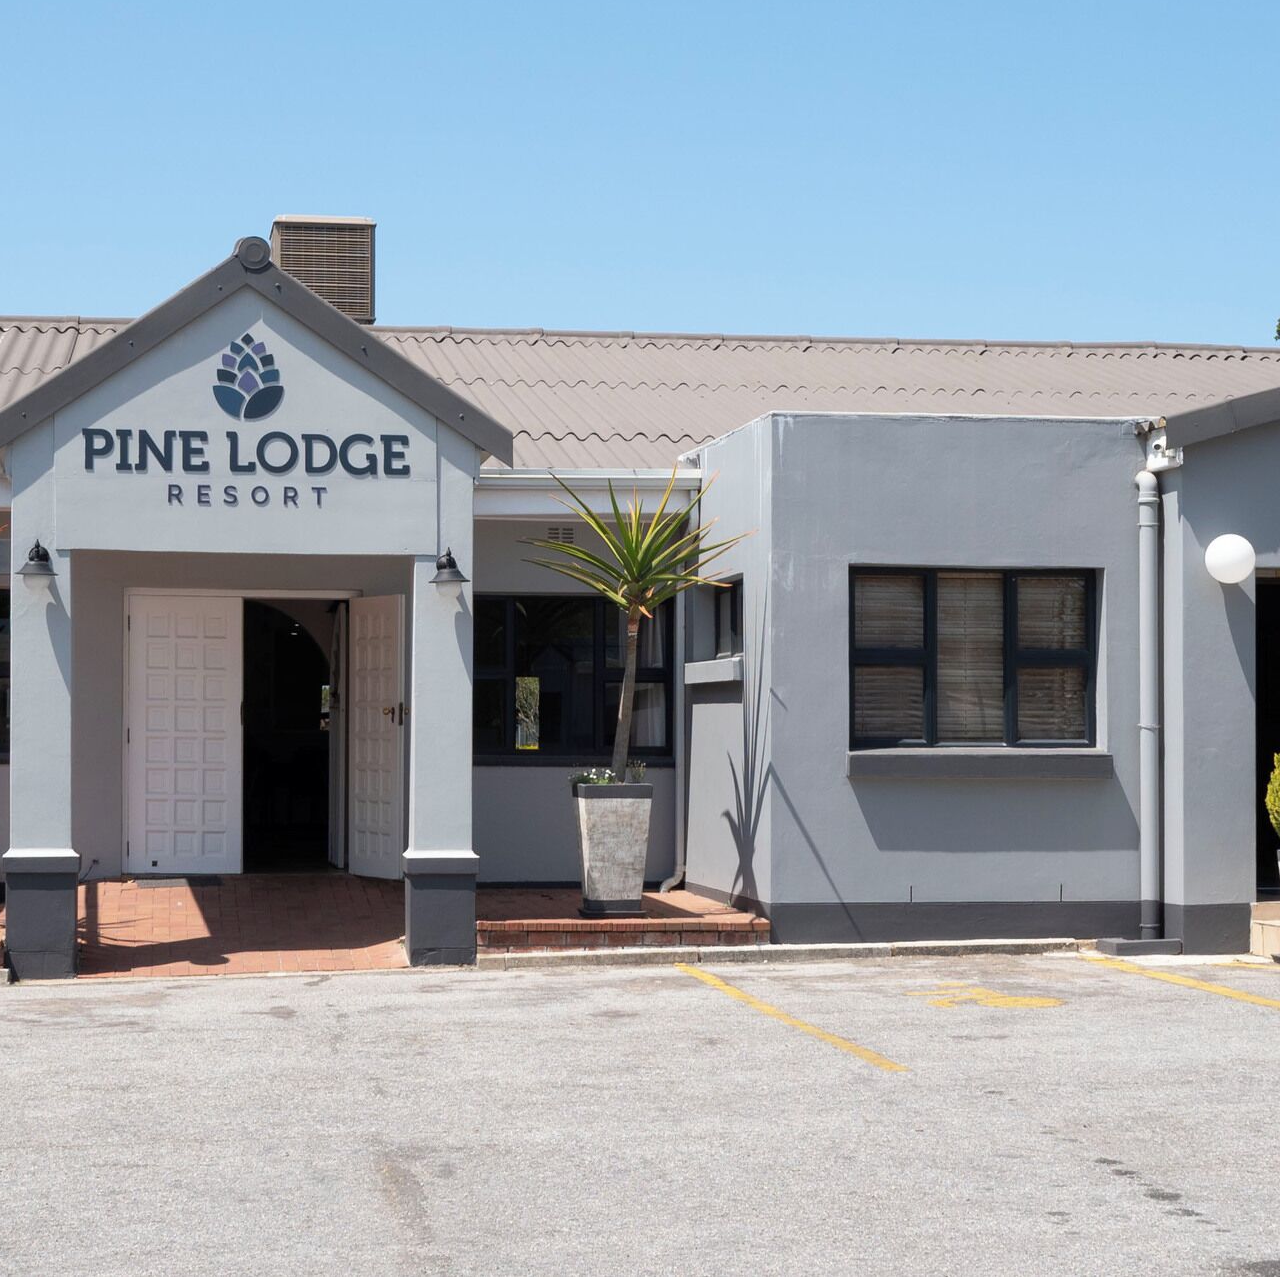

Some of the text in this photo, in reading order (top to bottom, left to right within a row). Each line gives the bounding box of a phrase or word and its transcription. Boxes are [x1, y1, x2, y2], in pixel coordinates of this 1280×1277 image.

[81, 428, 411, 476] PINE LODGE
[167, 484, 327, 506] RESORT
